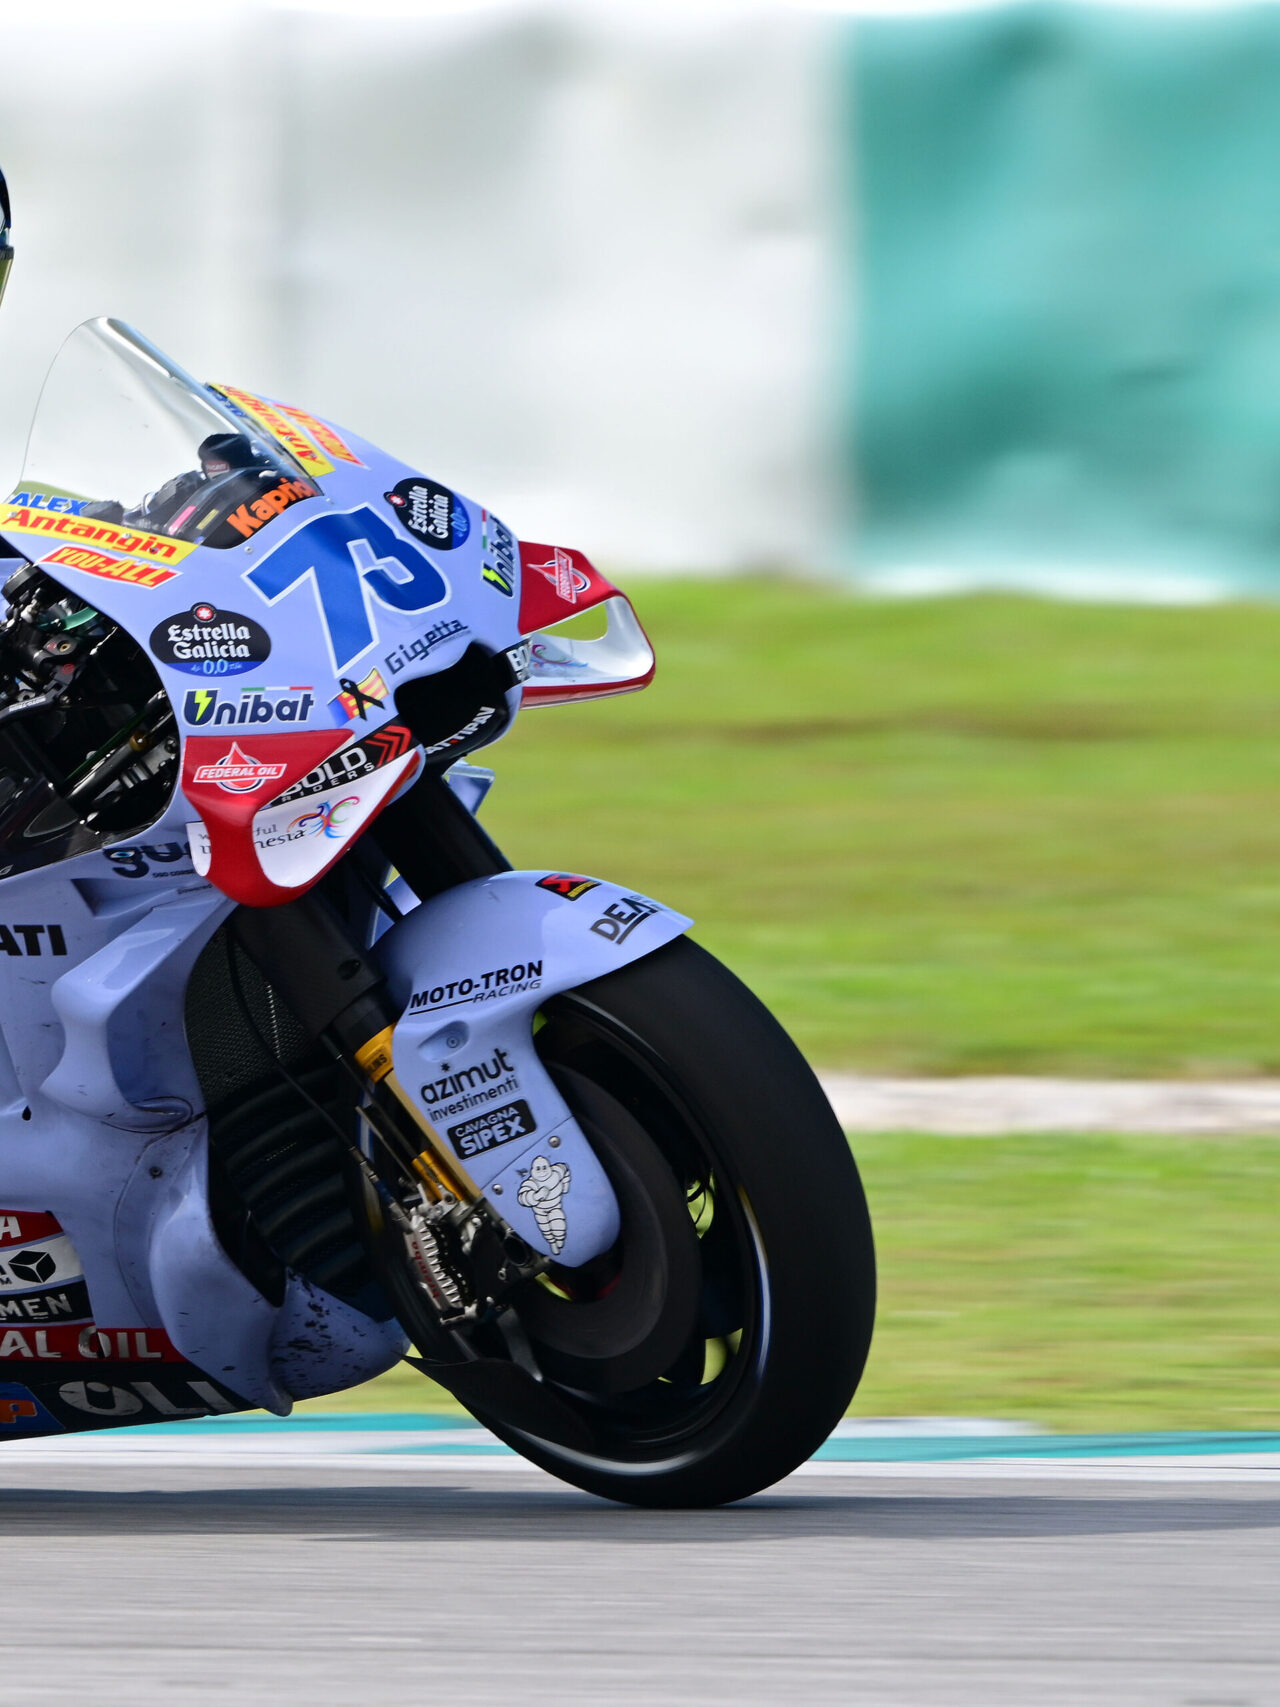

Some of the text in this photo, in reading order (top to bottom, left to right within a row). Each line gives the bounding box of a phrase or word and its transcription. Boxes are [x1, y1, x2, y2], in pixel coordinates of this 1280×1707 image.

[8, 492, 90, 517] ALEX
[407, 485, 428, 535] Estrella
[427, 493, 449, 540] Galicia
[1, 509, 178, 559] Antangin
[51, 547, 170, 587] YOU-ALL
[241, 503, 451, 679] 73
[167, 622, 251, 642] Estrella
[172, 640, 251, 660] Galicia
[384, 619, 469, 675] Gigetta
[183, 688, 315, 726] Unibat
[199, 766, 279, 779] FEDERAL OIL
[409, 960, 543, 1009] MOTO-TRON
[472, 978, 542, 1004] RACING
[420, 1048, 514, 1104] azimut
[427, 1074, 519, 1122] investimenti
[454, 1106, 519, 1137] CAVAGNA
[459, 1114, 526, 1156] SIPEX
[77, 1326, 163, 1359] OIL
